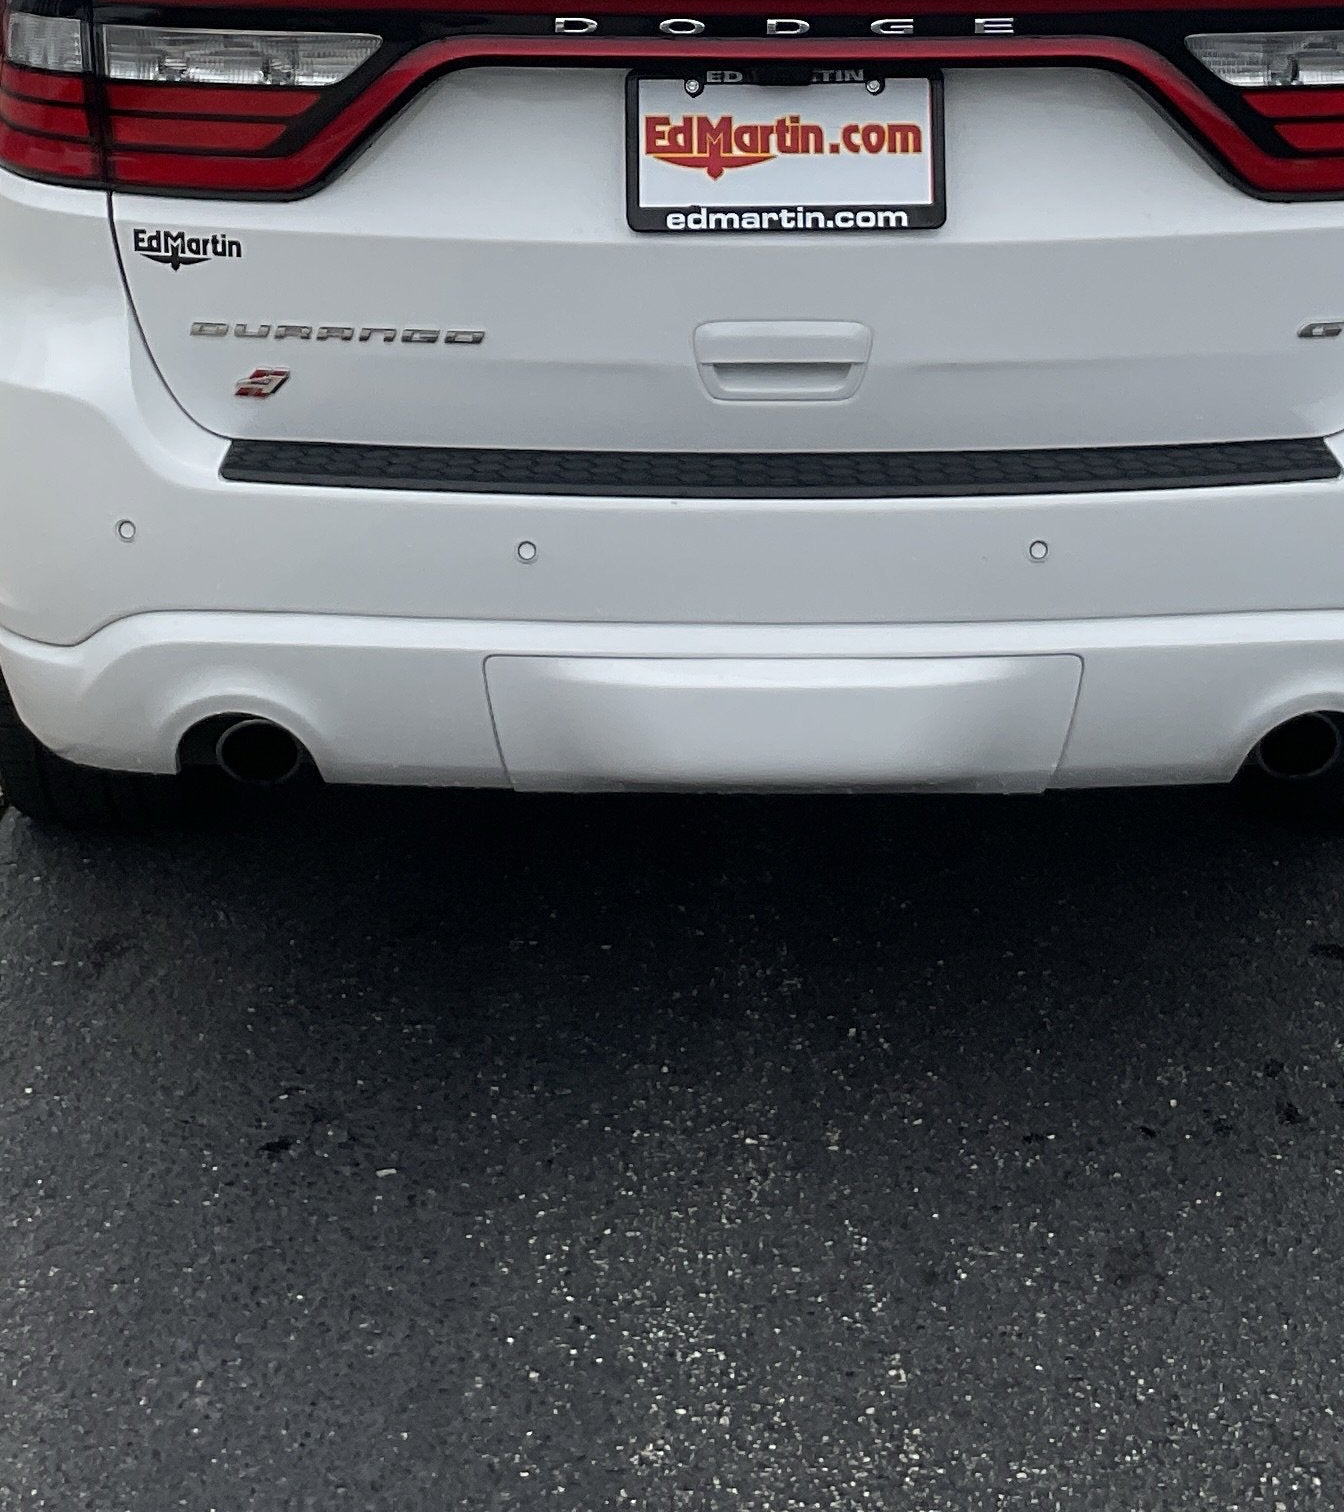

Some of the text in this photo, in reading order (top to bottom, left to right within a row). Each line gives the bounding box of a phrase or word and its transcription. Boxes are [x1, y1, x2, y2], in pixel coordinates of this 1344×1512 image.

[551, 17, 1016, 35] DODGE
[705, 70, 744, 83] ED
[644, 115, 923, 156] EdMartin.com
[666, 205, 909, 230] edmartin.com
[133, 228, 243, 259] EdMartin
[189, 321, 486, 344] DURANGO
